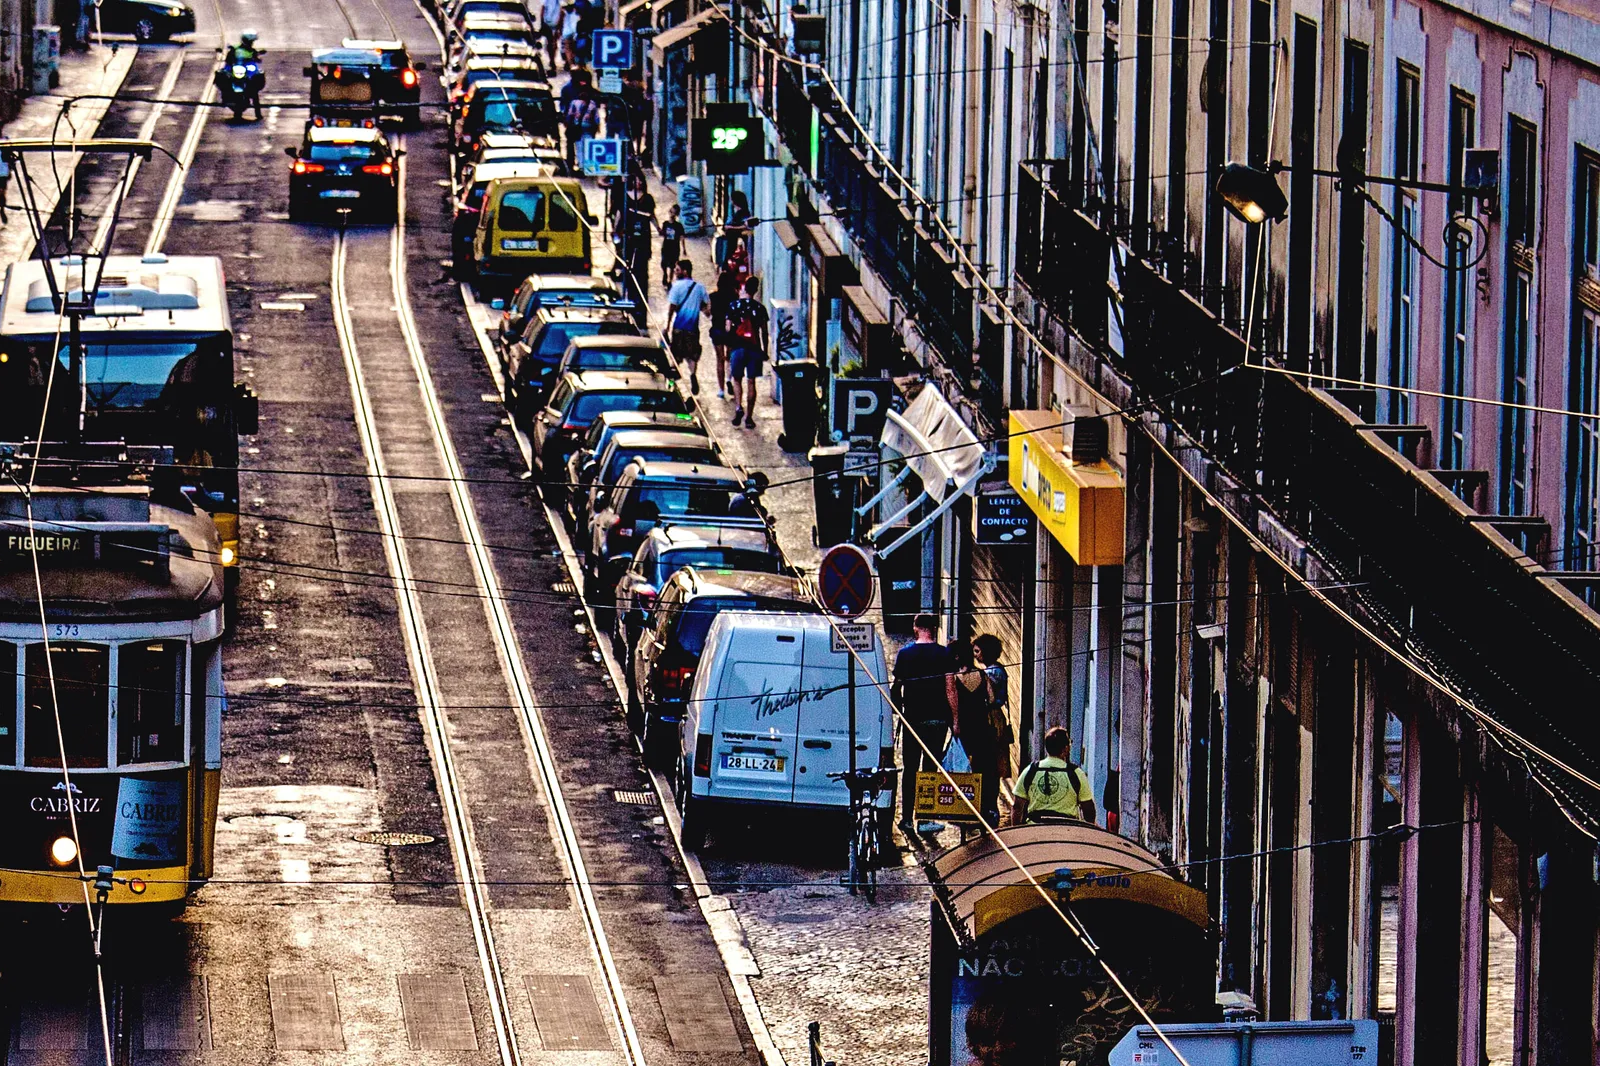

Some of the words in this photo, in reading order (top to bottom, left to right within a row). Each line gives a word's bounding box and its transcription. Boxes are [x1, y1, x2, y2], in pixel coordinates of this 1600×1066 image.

[601, 35, 622, 63] P
[592, 144, 606, 161] P
[847, 389, 878, 433] P
[989, 498, 1021, 506] LENTES
[981, 518, 1029, 526] CONTACTO
[8, 535, 81, 551] FIGUEIRA
[56, 624, 80, 636] 573
[940, 785, 953, 793] 714
[30, 796, 100, 813] CABRIZ
